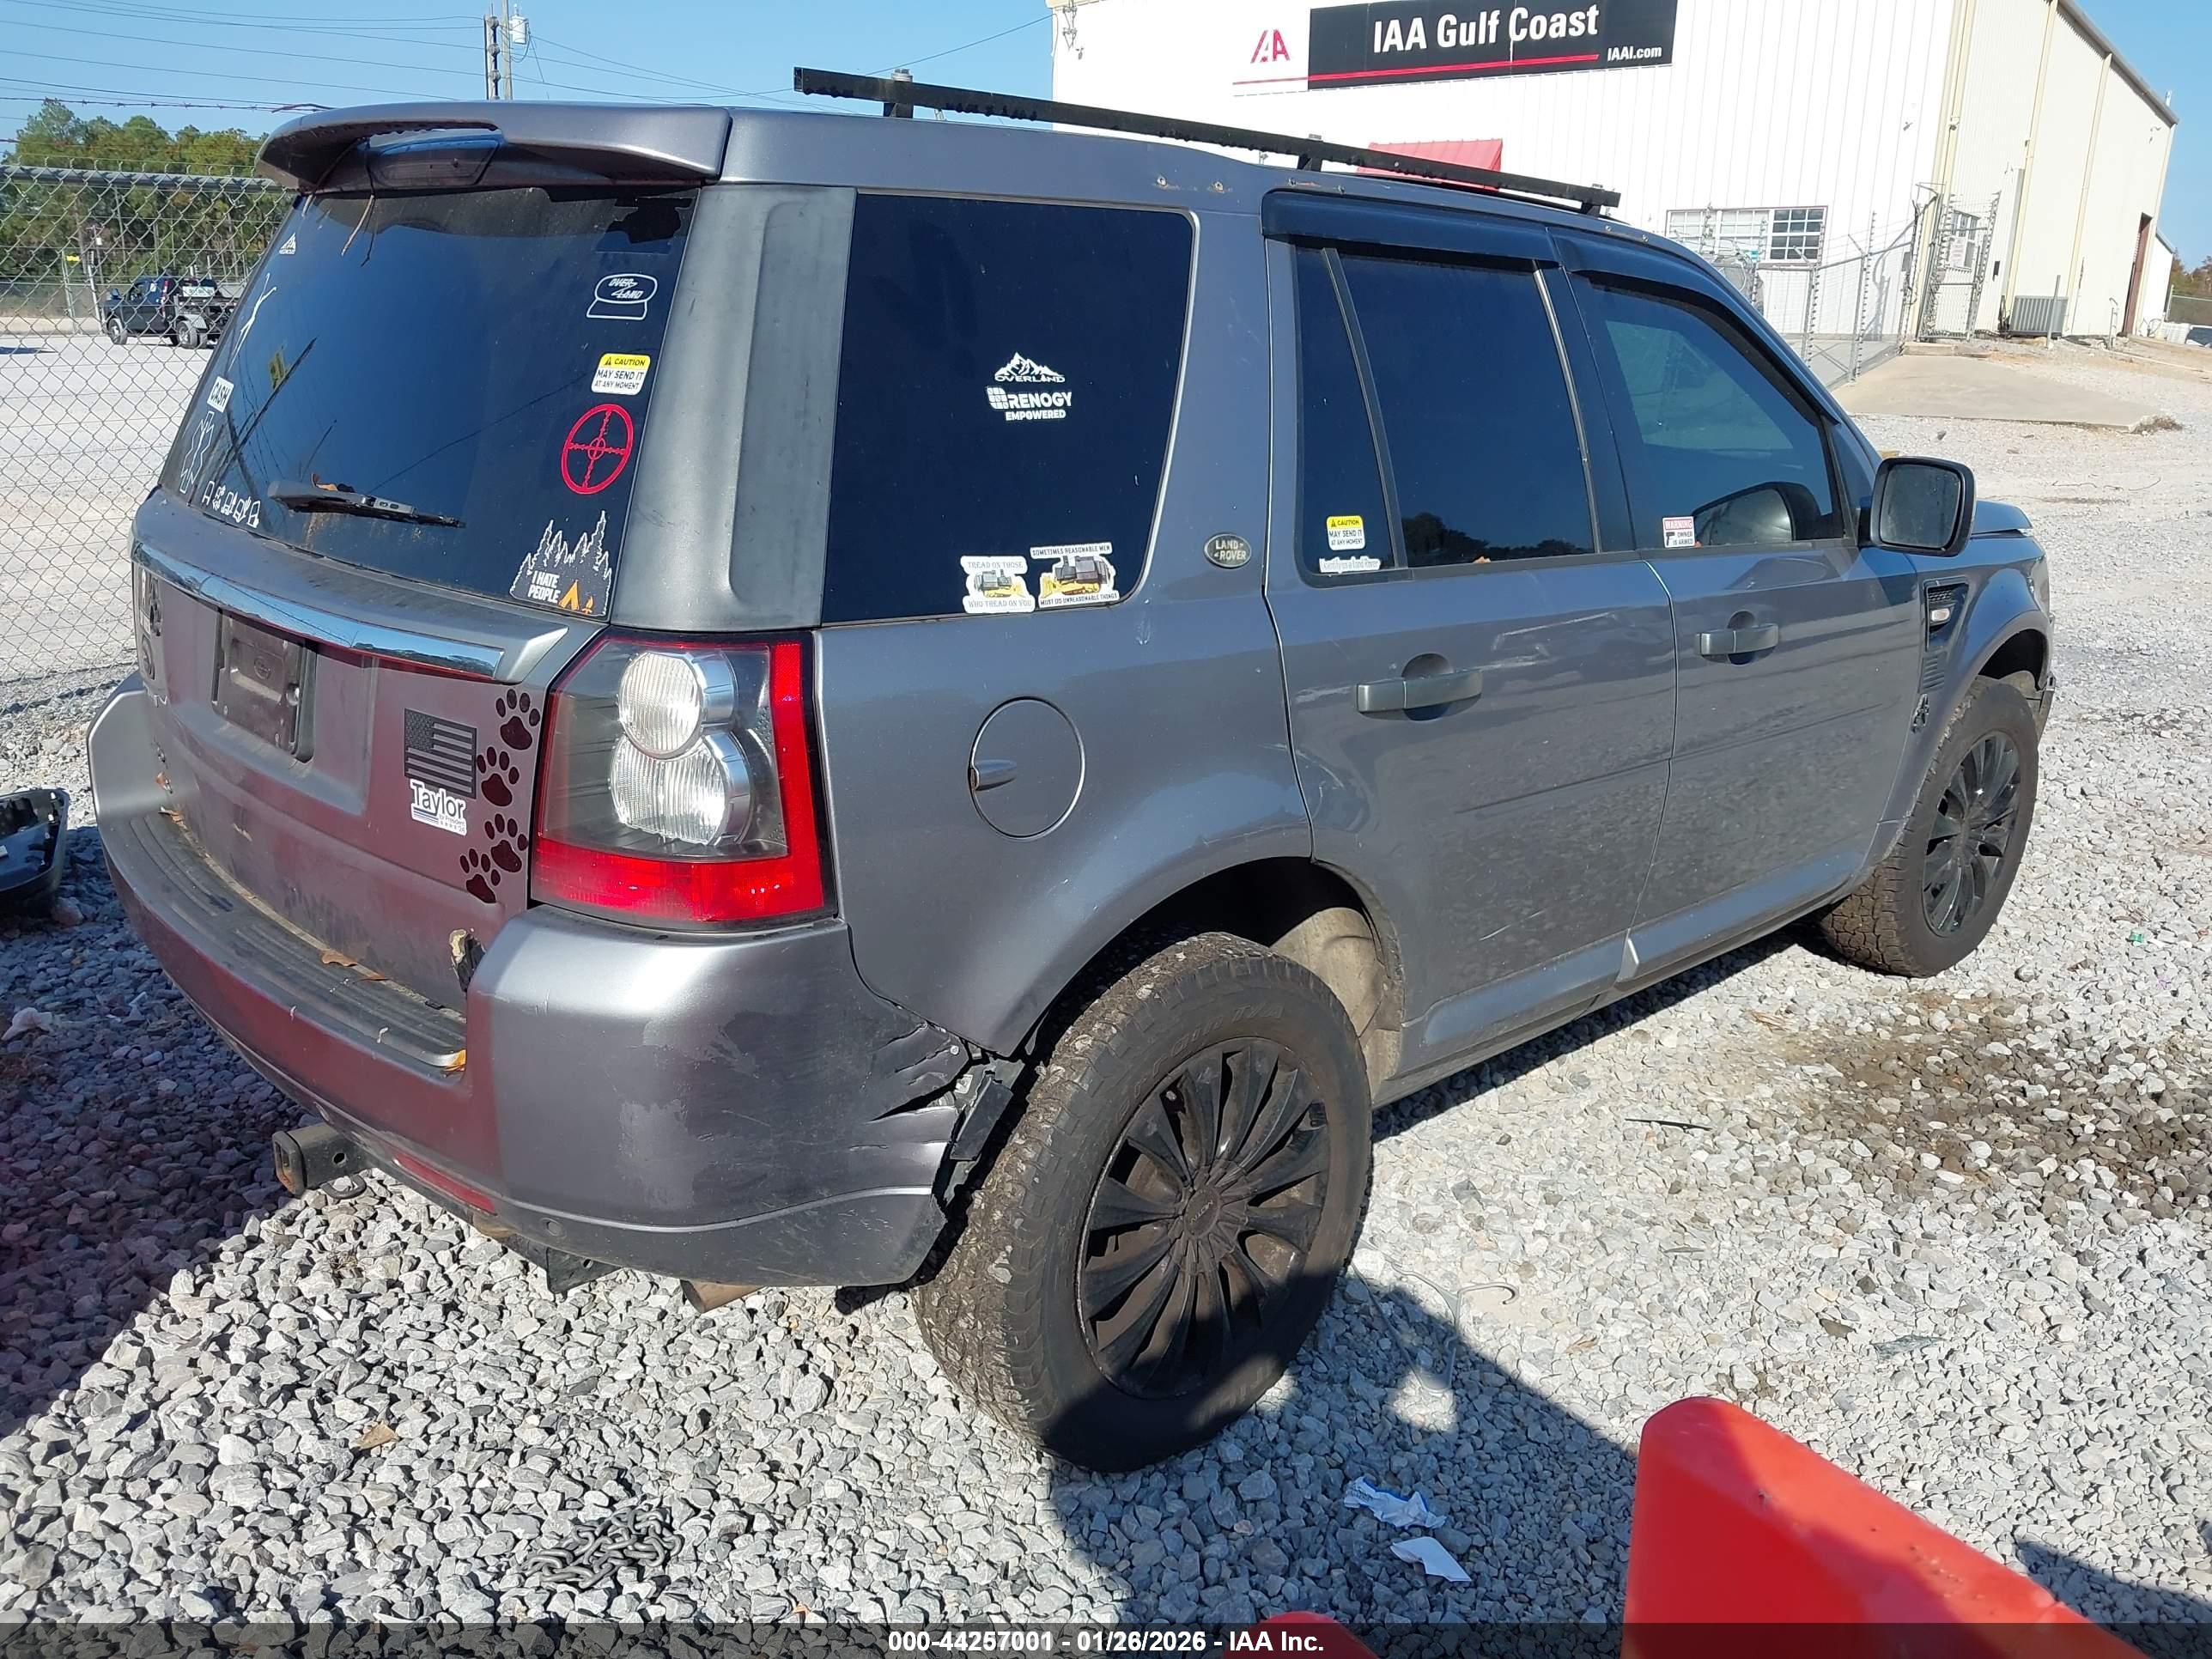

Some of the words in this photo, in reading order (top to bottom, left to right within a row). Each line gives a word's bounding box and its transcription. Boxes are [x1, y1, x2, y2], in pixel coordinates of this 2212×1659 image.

[1374, 17, 1427, 53] IAA
[1437, 10, 1500, 47] Gulf
[1510, 4, 1600, 42] Coast
[1607, 46, 1662, 61] IAAI.com
[614, 358, 646, 367] CAUTION
[596, 370, 613, 380] MAY
[615, 370, 635, 380] SEND
[635, 372, 645, 381] IT
[210, 381, 230, 407] CASH
[1007, 392, 1073, 409] RENOGY
[1005, 410, 1066, 421] EMPOWERED
[1665, 520, 1692, 529] WARNING
[1215, 539, 1238, 550] LAND
[1032, 548, 1064, 556] SOMETIMES
[1065, 545, 1098, 555] REASONABLE
[1219, 550, 1247, 562] ROVER
[532, 570, 538, 583] I
[537, 571, 560, 588] HATE
[527, 585, 562, 604] PEOPLE
[1063, 595, 1100, 604] UNREASONABLE
[1019, 599, 1032, 607] YOU
[412, 782, 464, 818] Taylor
